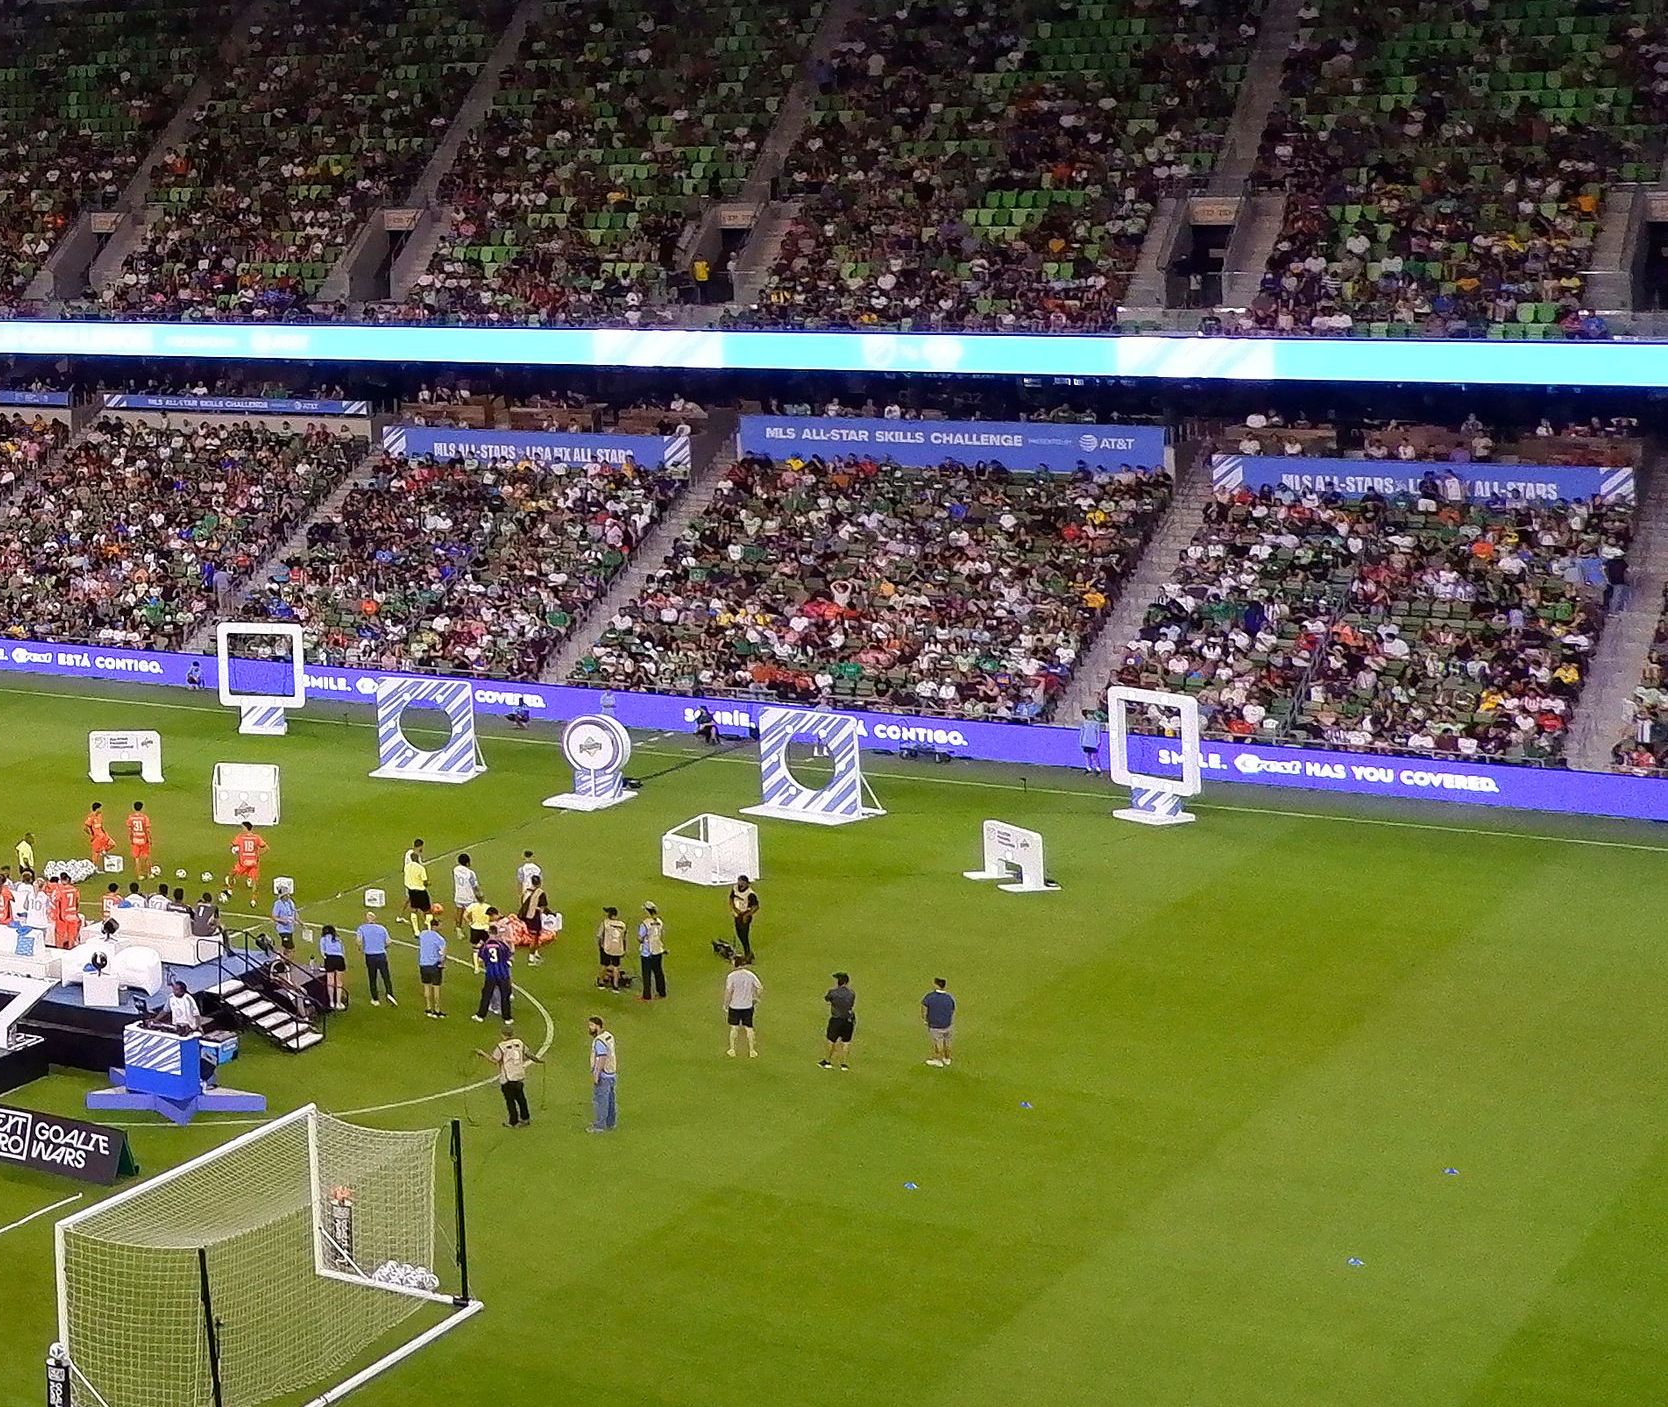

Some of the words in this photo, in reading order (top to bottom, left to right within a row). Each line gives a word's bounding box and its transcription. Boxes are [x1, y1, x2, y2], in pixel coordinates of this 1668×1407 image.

[766, 427, 795, 439] MLS
[802, 429, 869, 442] ALL-STAR
[876, 431, 924, 444] SKILLS
[931, 432, 1022, 447] CHALLENGE
[1100, 438, 1135, 450] AT&T
[95, 656, 163, 674] CONTIGO.
[874, 724, 968, 746] CONTIGO.
[1158, 749, 1227, 769] SMLE.
[1306, 762, 1346, 779] HAS
[1351, 765, 1394, 782] YOU
[1400, 769, 1499, 793] COVERED.
[133, 821, 143, 832] 31
[244, 841, 254, 851] 18
[66, 893, 75, 906] 7
[489, 948, 498, 963] 3
[35, 1122, 110, 1155] GOALIE
[31, 1140, 86, 1169] WARS
